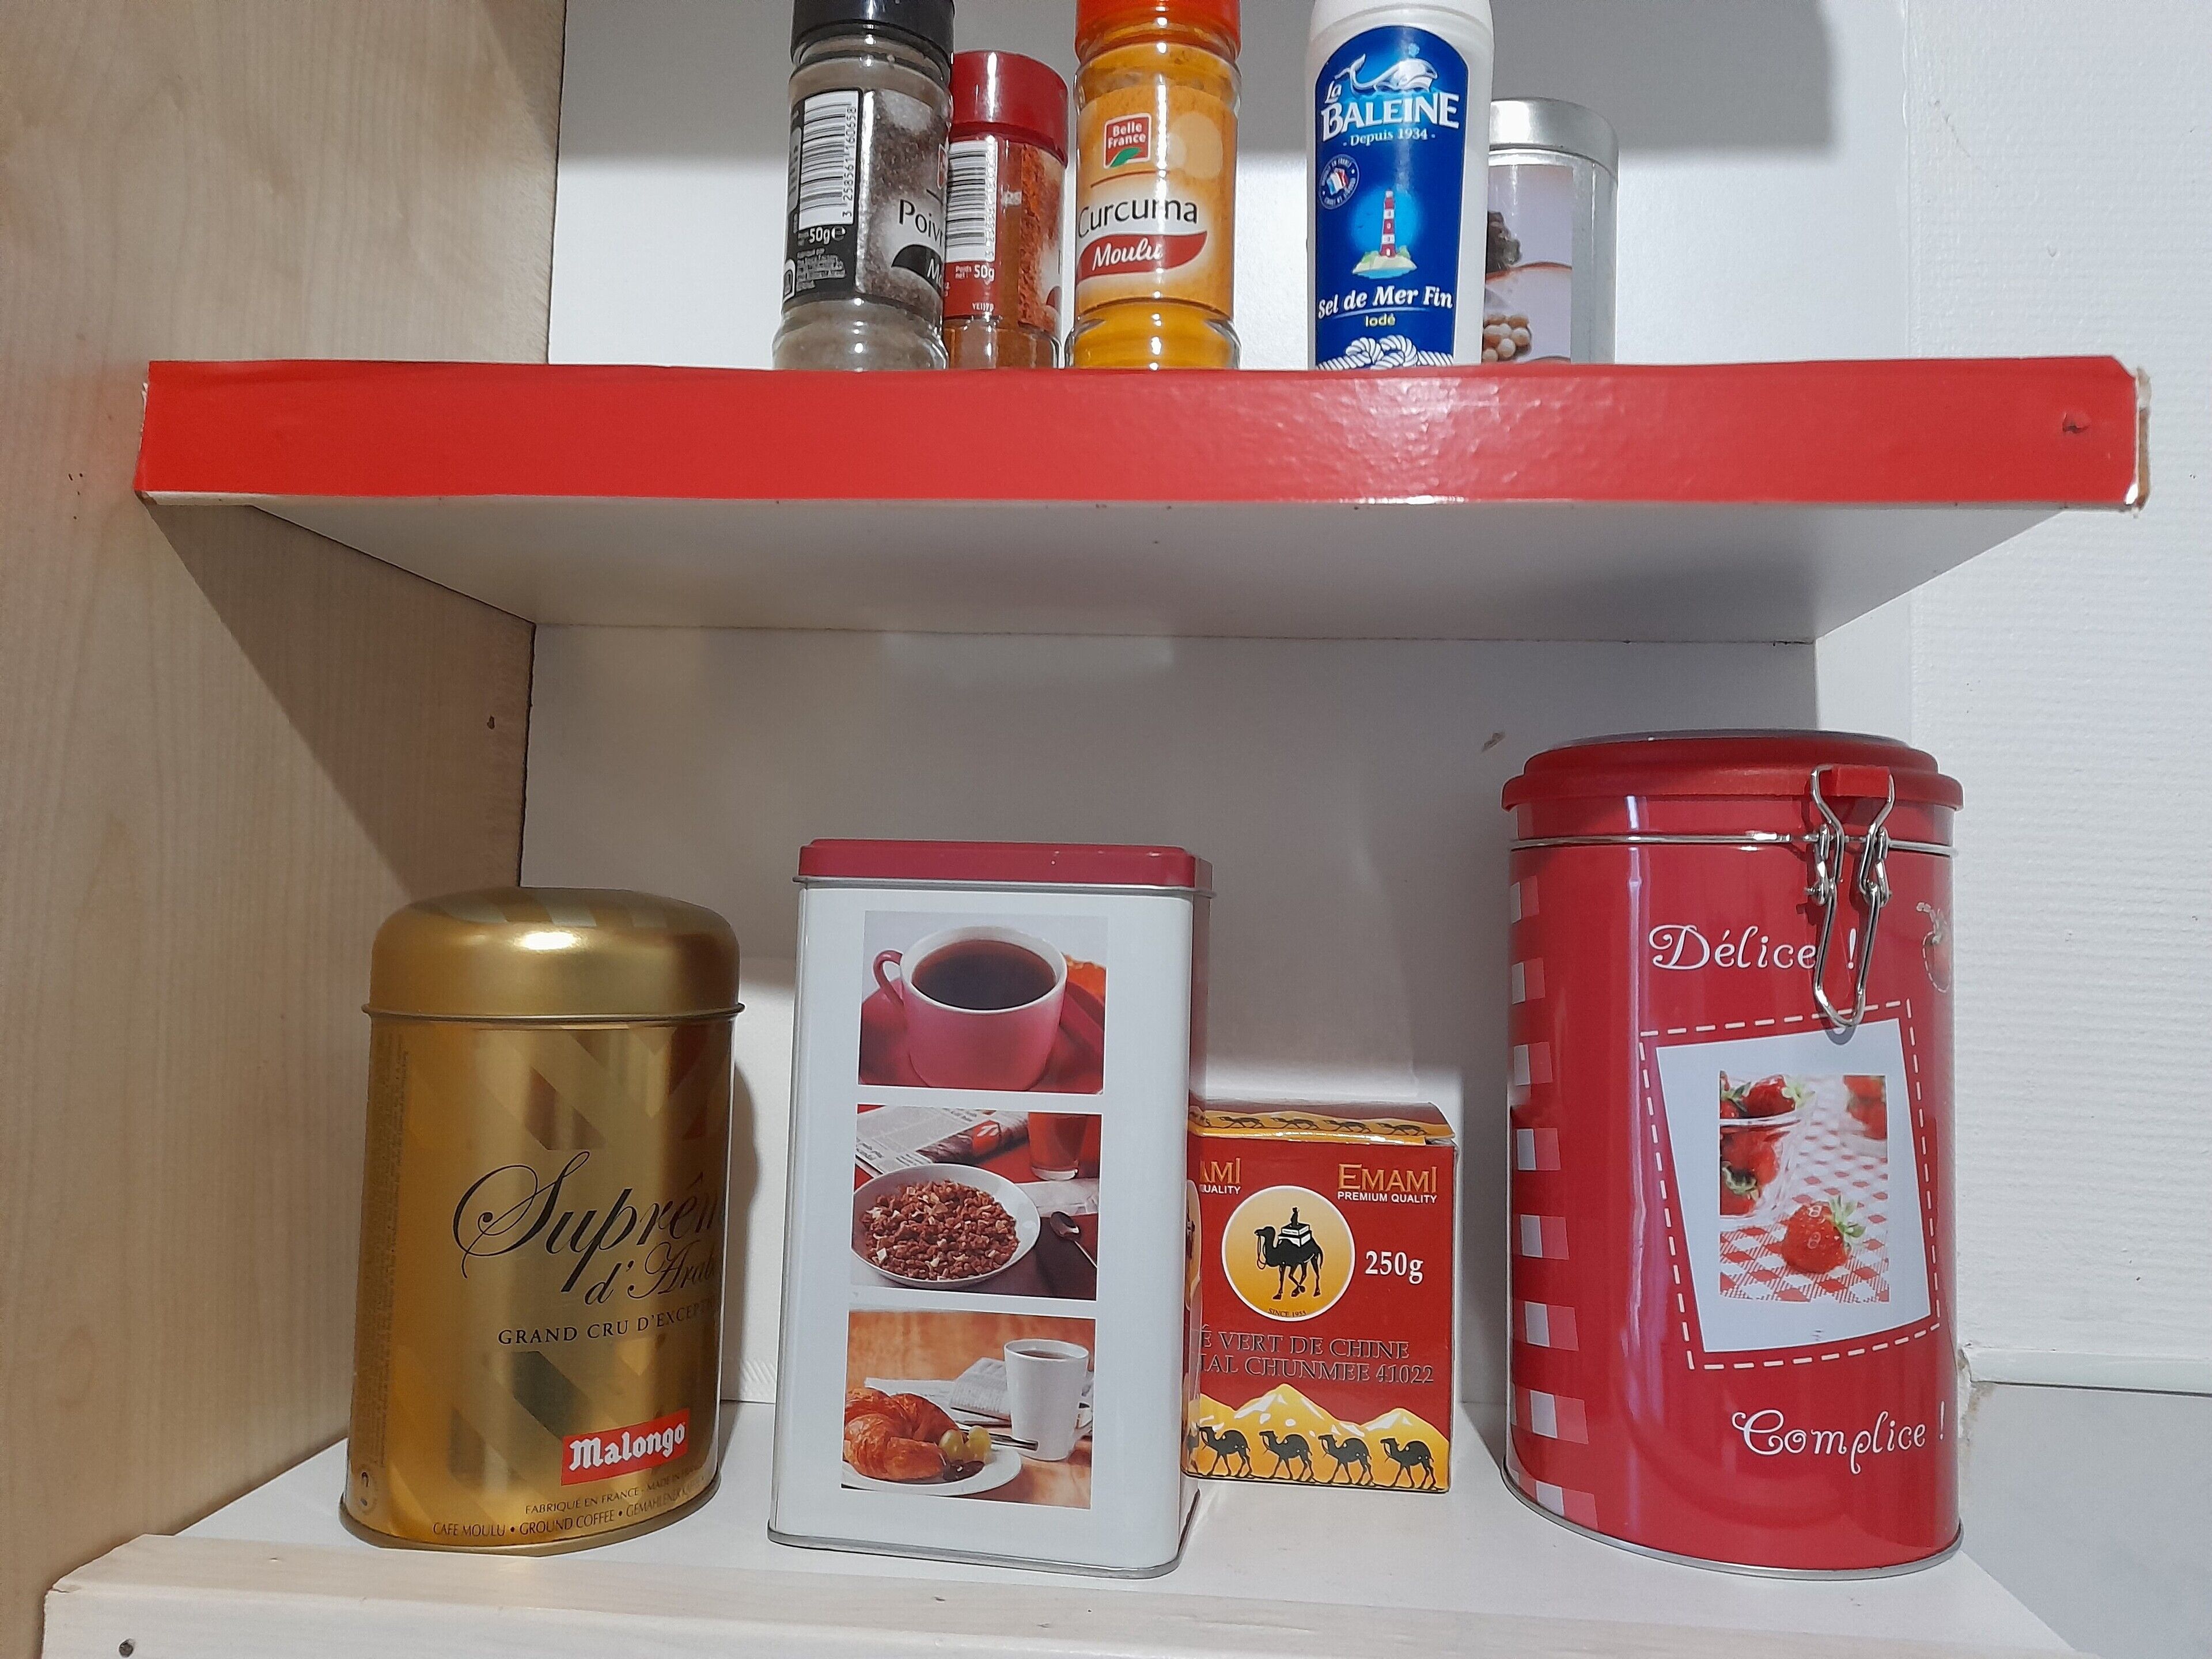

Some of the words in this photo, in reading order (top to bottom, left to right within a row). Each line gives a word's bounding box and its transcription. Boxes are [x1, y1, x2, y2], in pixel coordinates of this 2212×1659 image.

[1325, 80, 1342, 103] La
[1113, 121, 1142, 137] Belle
[1321, 91, 1460, 142] BALEINE
[1108, 133, 1146, 149] France
[1350, 129, 1393, 147] Depuis
[1398, 127, 1429, 140] 1934
[1092, 237, 1163, 271] Moulu
[974, 264, 995, 282] 50g
[1317, 294, 1339, 319] Sel
[1343, 290, 1368, 310] de
[1372, 285, 1419, 306] Mer
[1423, 286, 1453, 309] Fin
[1649, 924, 1817, 971] Délice
[1338, 1163, 1437, 1193] EMAMI
[1337, 1190, 1388, 1202] PREMIUM
[1391, 1193, 1437, 1204] QUALITY
[1364, 1250, 1424, 1285] 250g
[1268, 1308, 1289, 1317] SINCE
[498, 1326, 577, 1345] GRAND
[586, 1319, 628, 1339] CRU
[1218, 1331, 1283, 1353] VERT
[1290, 1336, 1323, 1355] DE
[1329, 1338, 1410, 1359] CHINE
[1376, 1364, 1434, 1384] 41022
[569, 1423, 686, 1472] Malongo
[1732, 1409, 1926, 1475] Complice
[584, 1497, 598, 1508] EN
[601, 1487, 639, 1503] FRANCE
[462, 1523, 506, 1537] MOULU
[520, 1517, 573, 1535] GROUND
[577, 1509, 614, 1528] COFFEE
